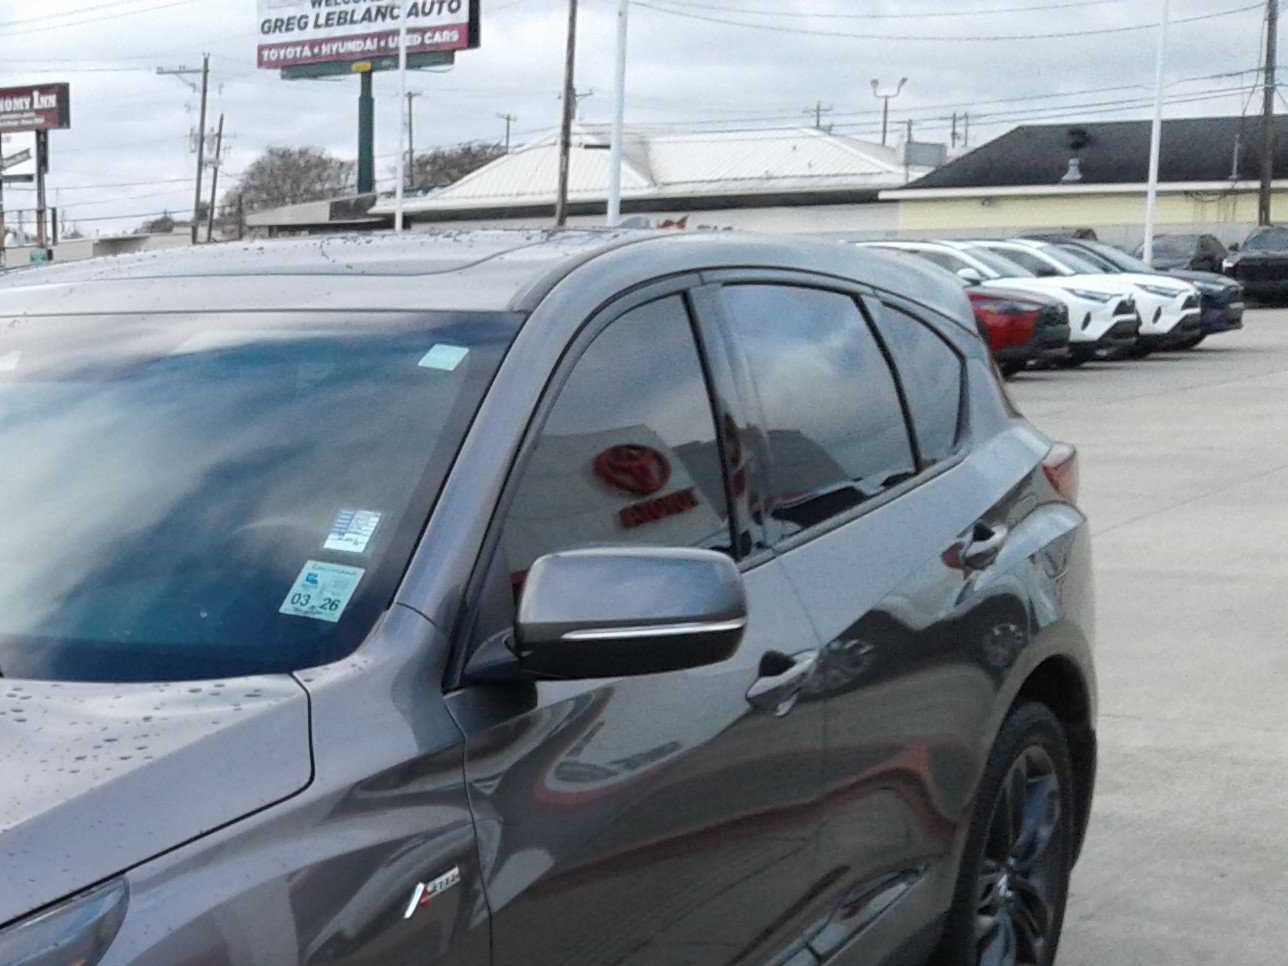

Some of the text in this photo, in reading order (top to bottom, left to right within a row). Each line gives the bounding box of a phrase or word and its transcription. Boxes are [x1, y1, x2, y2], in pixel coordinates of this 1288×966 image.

[260, 0, 461, 35] GREG LEBLANC AUTO
[261, 29, 459, 62] TOYOTA HYUNDAI UED CARS
[290, 592, 311, 607] 03
[319, 597, 341, 612] 26
